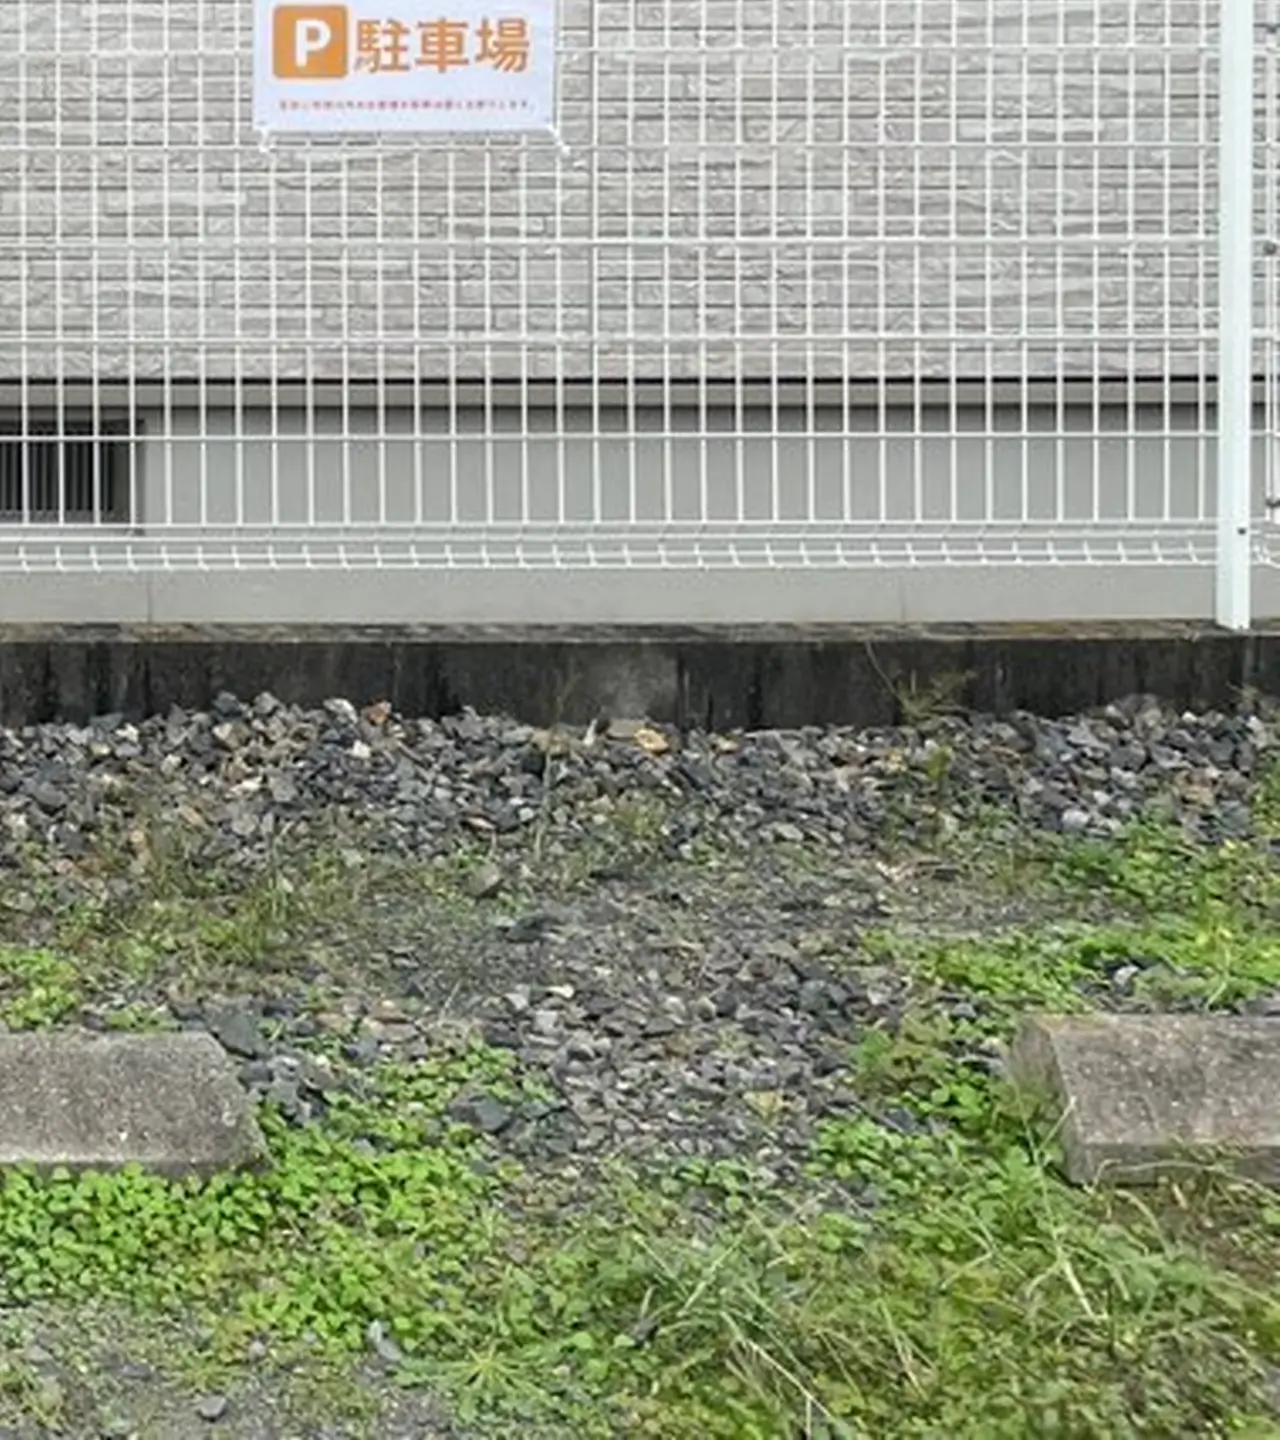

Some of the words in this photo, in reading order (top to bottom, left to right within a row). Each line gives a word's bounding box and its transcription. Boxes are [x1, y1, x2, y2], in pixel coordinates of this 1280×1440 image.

[294, 18, 332, 68] P
[354, 16, 531, 74] 駐車場
